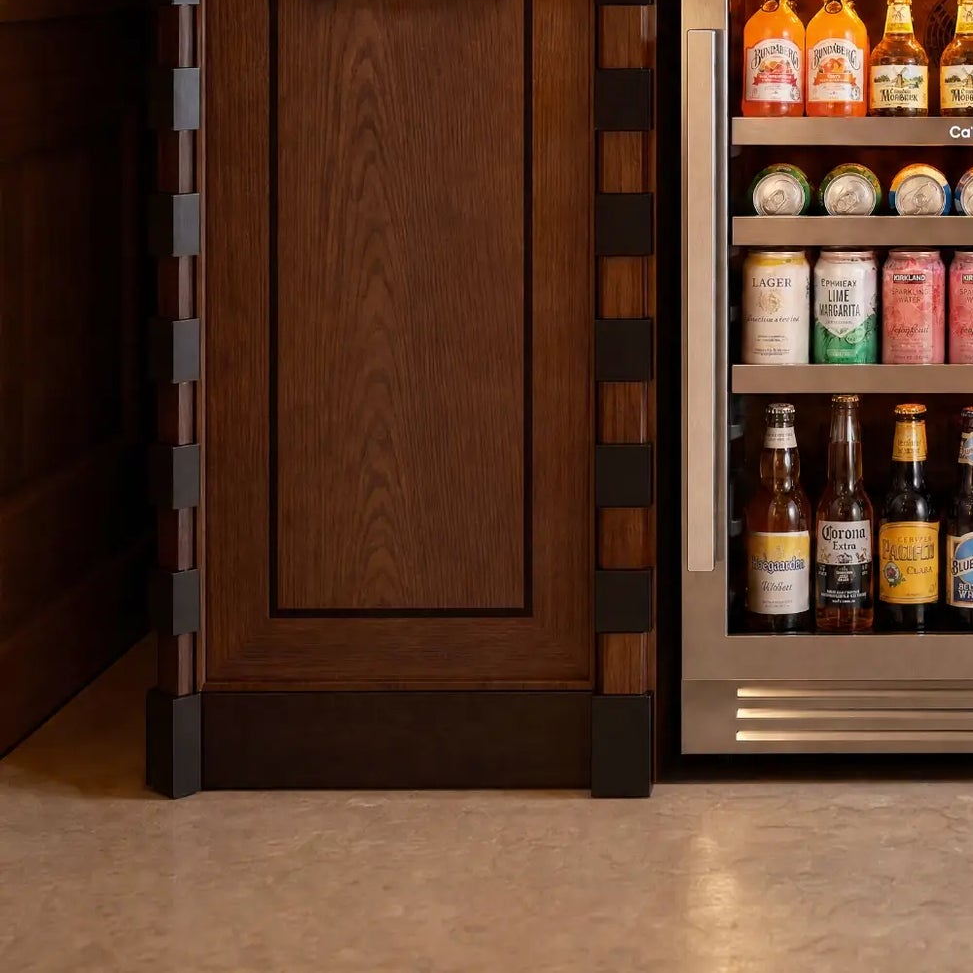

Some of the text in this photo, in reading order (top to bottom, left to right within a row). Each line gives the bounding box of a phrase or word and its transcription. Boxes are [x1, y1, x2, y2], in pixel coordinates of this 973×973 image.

[752, 277, 792, 288] LAGER
[828, 289, 850, 303] LIME
[819, 303, 861, 317] MARGARITA
[821, 525, 867, 541] Corona
[832, 541, 857, 551] Extra
